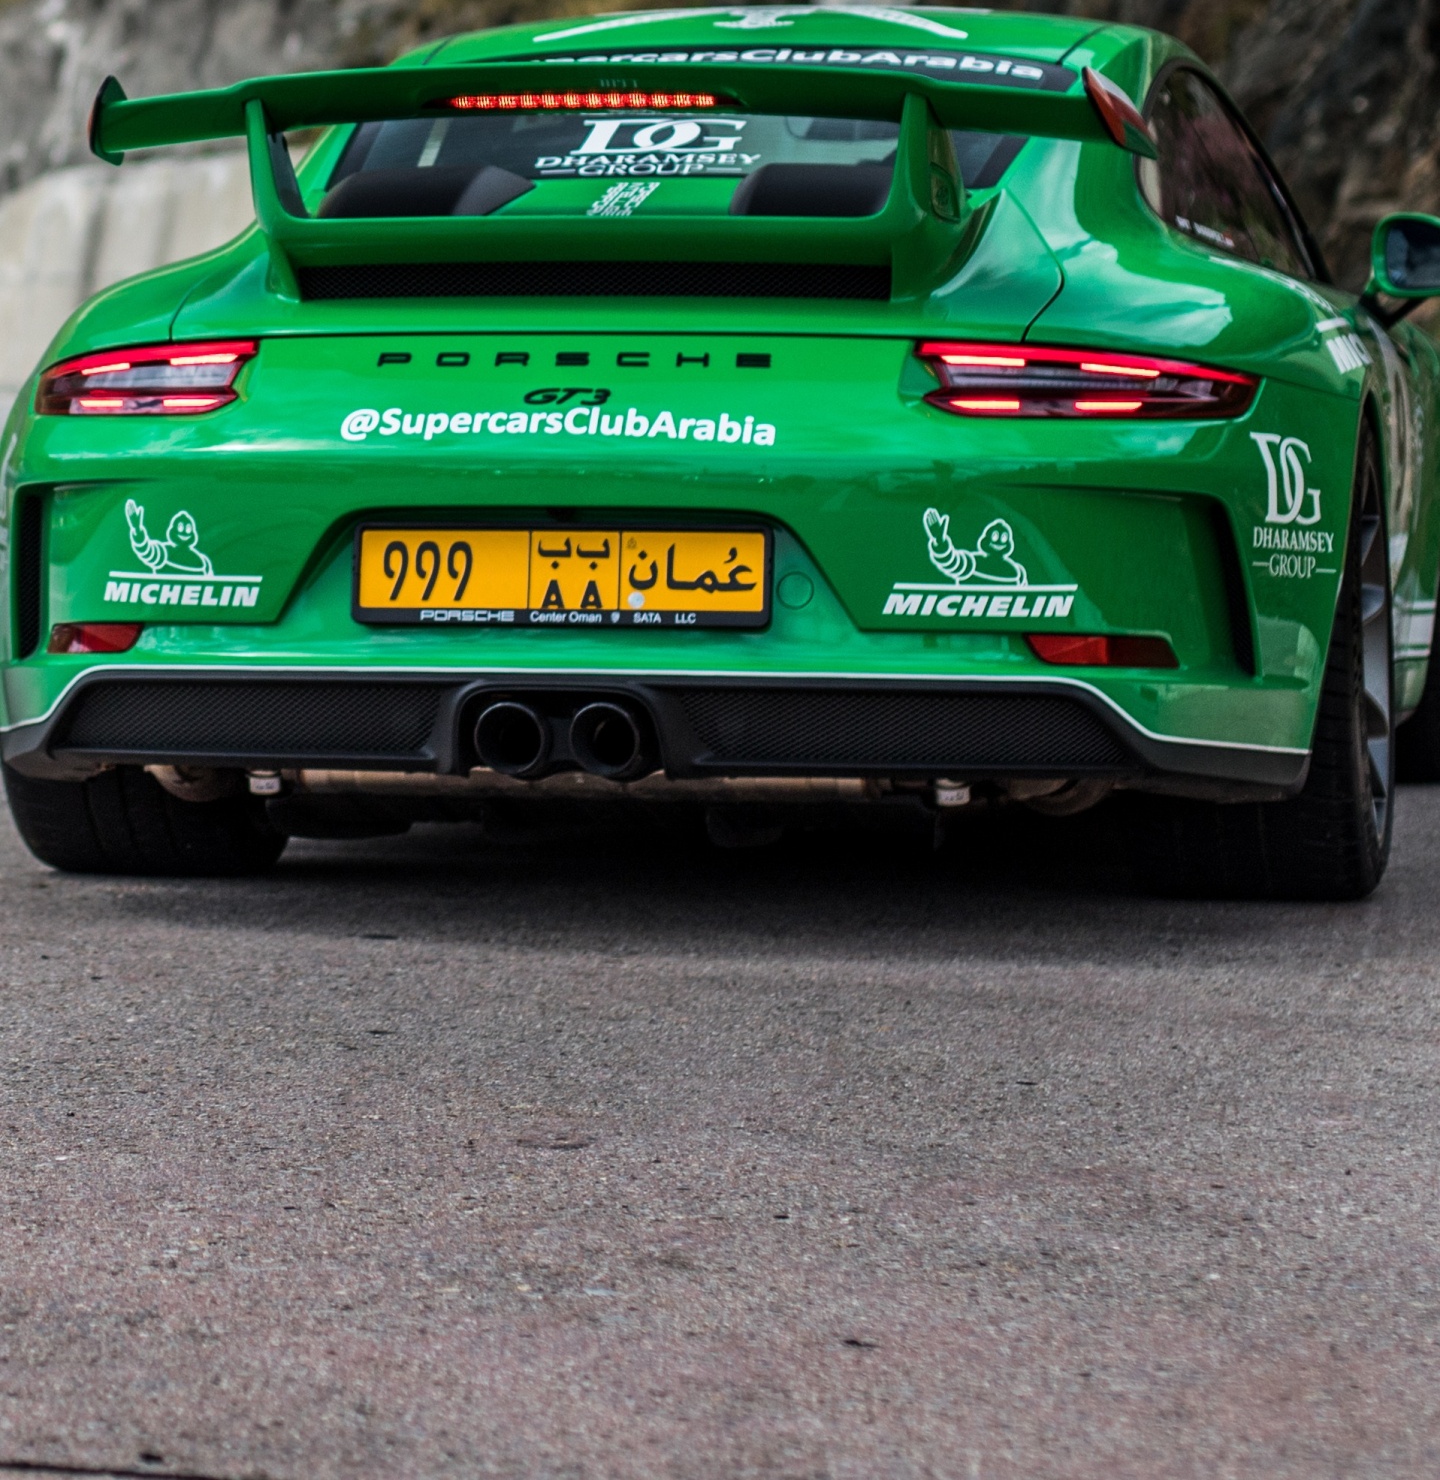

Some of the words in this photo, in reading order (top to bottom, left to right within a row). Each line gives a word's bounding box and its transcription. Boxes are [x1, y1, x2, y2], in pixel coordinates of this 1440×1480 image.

[534, 153, 761, 169] DHARAMSEY
[577, 163, 704, 176] GROUP
[377, 352, 772, 368] PORSCHE
[523, 388, 611, 405] GT3
[340, 407, 776, 446] @SupercarsClubArabia
[1253, 526, 1334, 553] DHARAMSEY
[383, 540, 473, 602] 999
[1269, 553, 1316, 579] GROUP
[103, 581, 260, 607] MICHELIN
[882, 594, 1075, 618] MICHELIN
[420, 610, 515, 622] PORSCHE
[530, 611, 566, 623] Center
[568, 611, 602, 624] Oman
[633, 612, 662, 624] SATA
[675, 613, 697, 624] LLC
